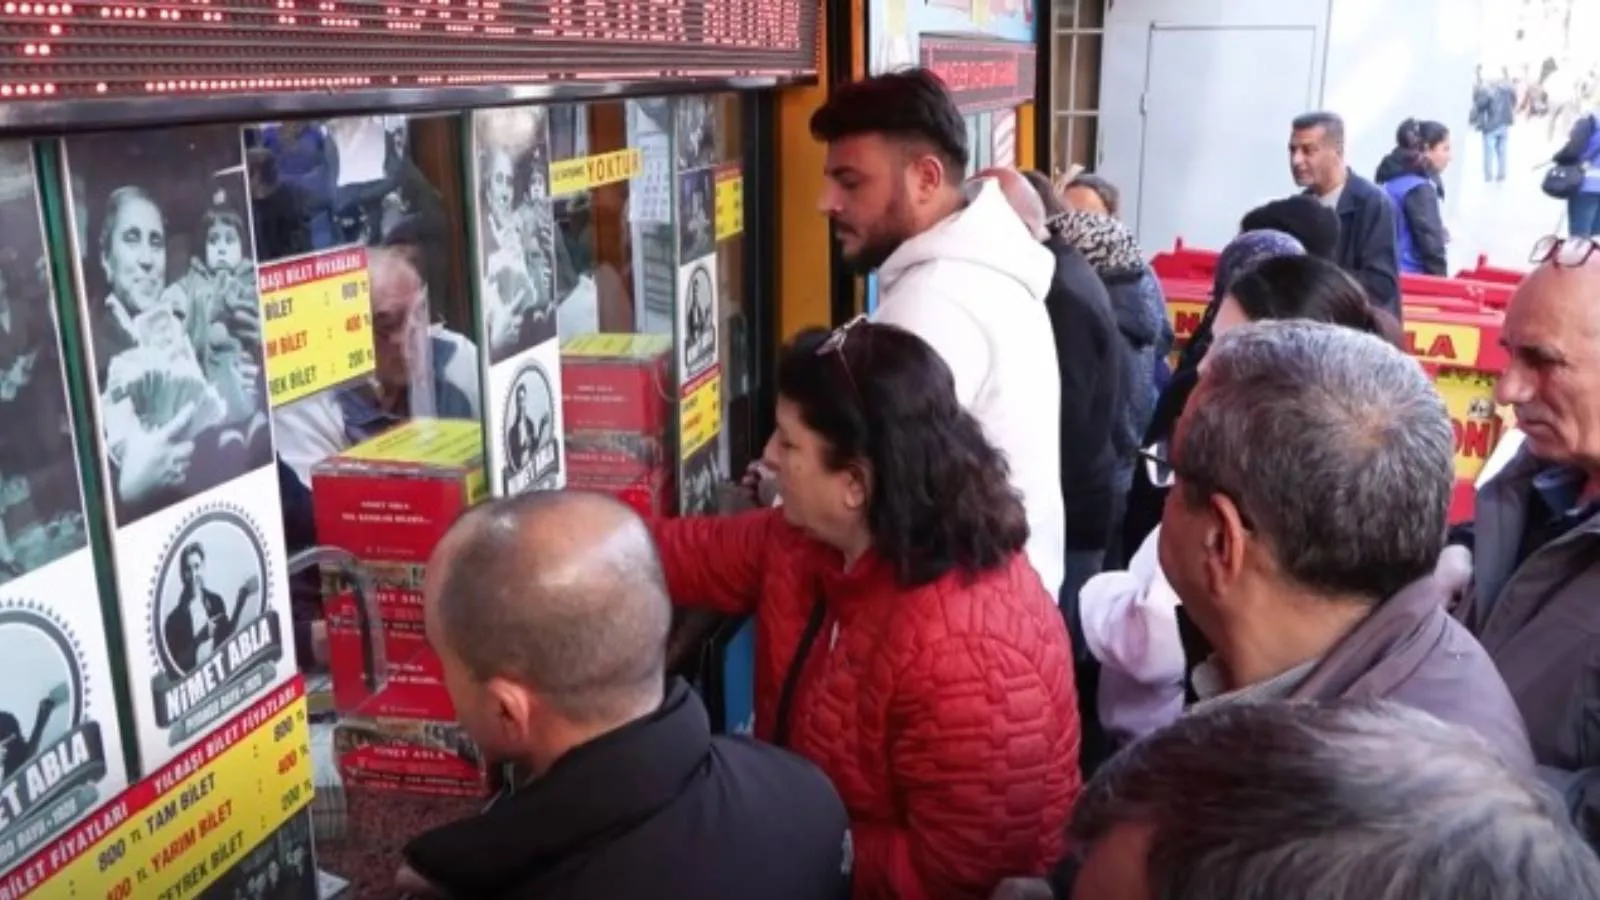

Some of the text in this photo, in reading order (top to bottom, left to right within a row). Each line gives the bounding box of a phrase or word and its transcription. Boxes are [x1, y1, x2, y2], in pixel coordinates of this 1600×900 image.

[587, 152, 639, 183] YOKTUR
[165, 651, 225, 722] NİMET
[228, 617, 272, 671] ABLA
[26, 731, 91, 800] ABLA
[50, 801, 129, 869] FİYATLARI
[146, 799, 177, 836] TAM
[180, 771, 215, 811] BİLET
[150, 827, 197, 873] YARIM
[198, 799, 232, 840] BİLET
[98, 838, 126, 872] 800
[210, 830, 243, 870] BİLET
